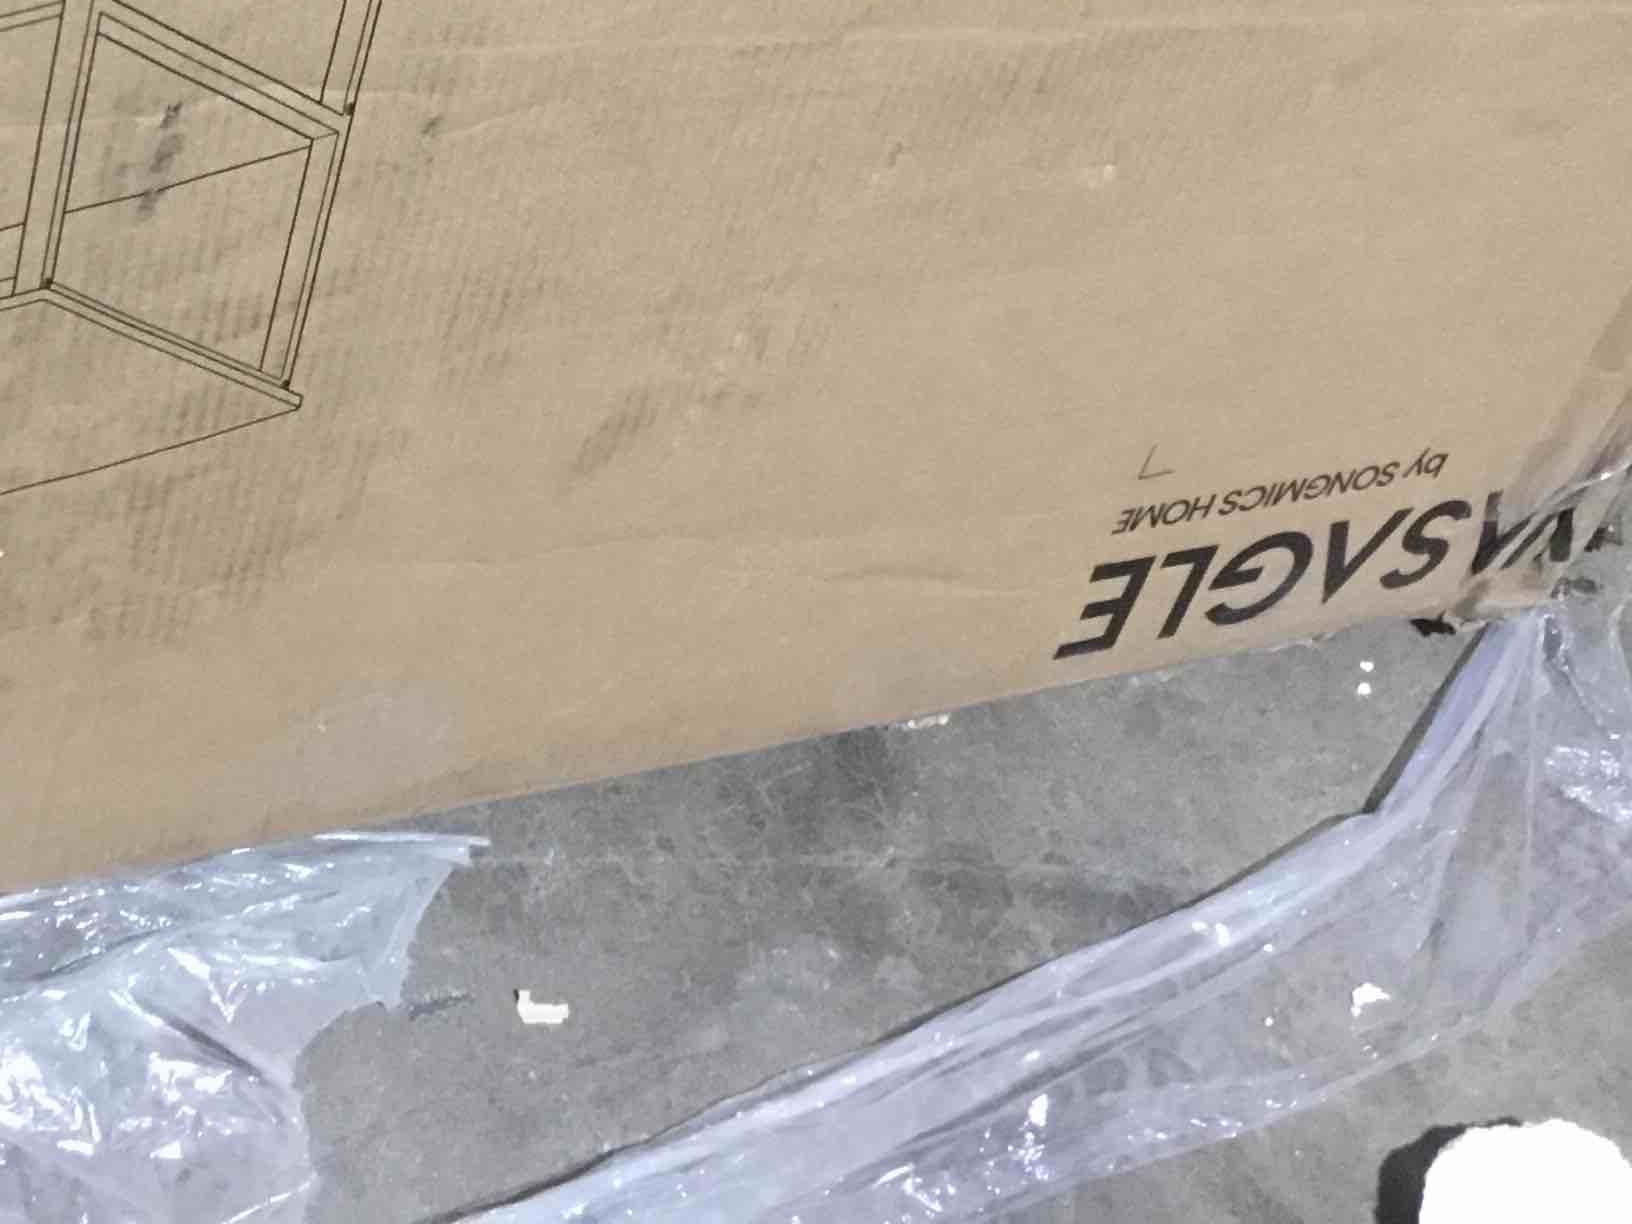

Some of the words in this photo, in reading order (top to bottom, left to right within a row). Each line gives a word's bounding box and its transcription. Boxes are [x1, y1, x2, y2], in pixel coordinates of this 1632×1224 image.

[1216, 458, 1403, 514] SONGMICS
[1407, 444, 1450, 479] by
[1111, 491, 1219, 537] HOME
[1052, 489, 1575, 660] VASAGLE
